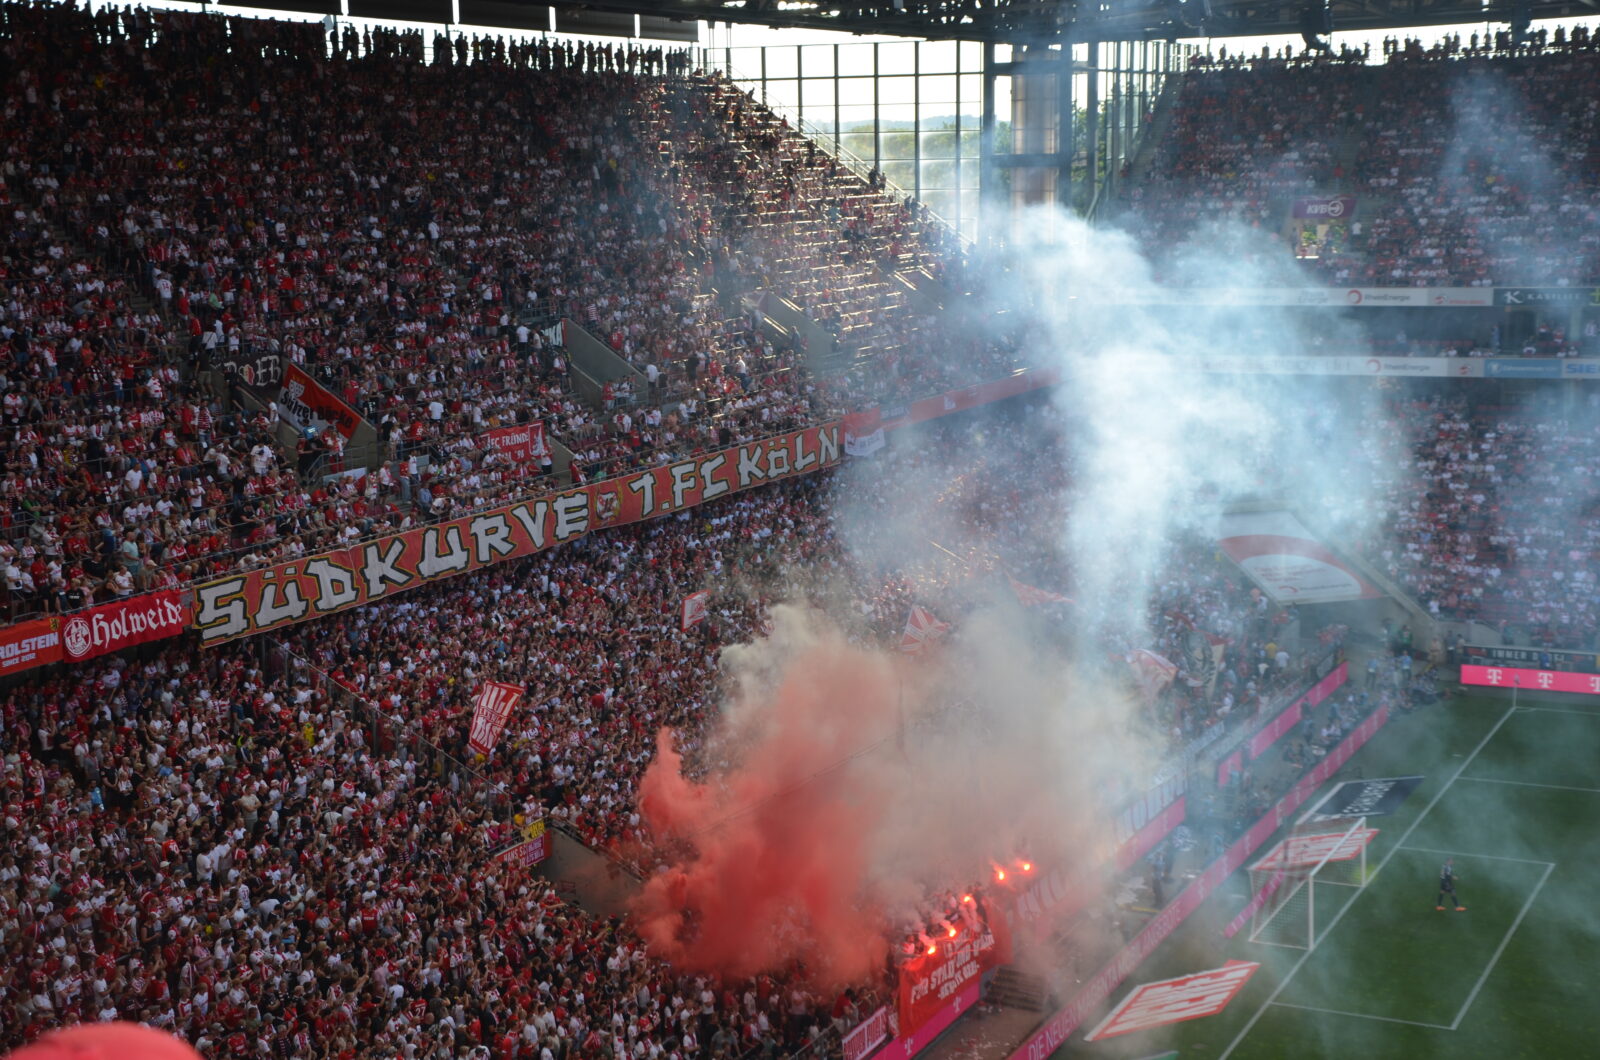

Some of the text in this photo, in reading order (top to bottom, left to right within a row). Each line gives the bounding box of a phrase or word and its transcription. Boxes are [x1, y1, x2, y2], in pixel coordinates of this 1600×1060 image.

[1306, 204, 1328, 214] KVB
[200, 494, 590, 642] SÜDKURVE
[737, 428, 840, 486] KÖLN
[92, 598, 183, 649] Holweide
